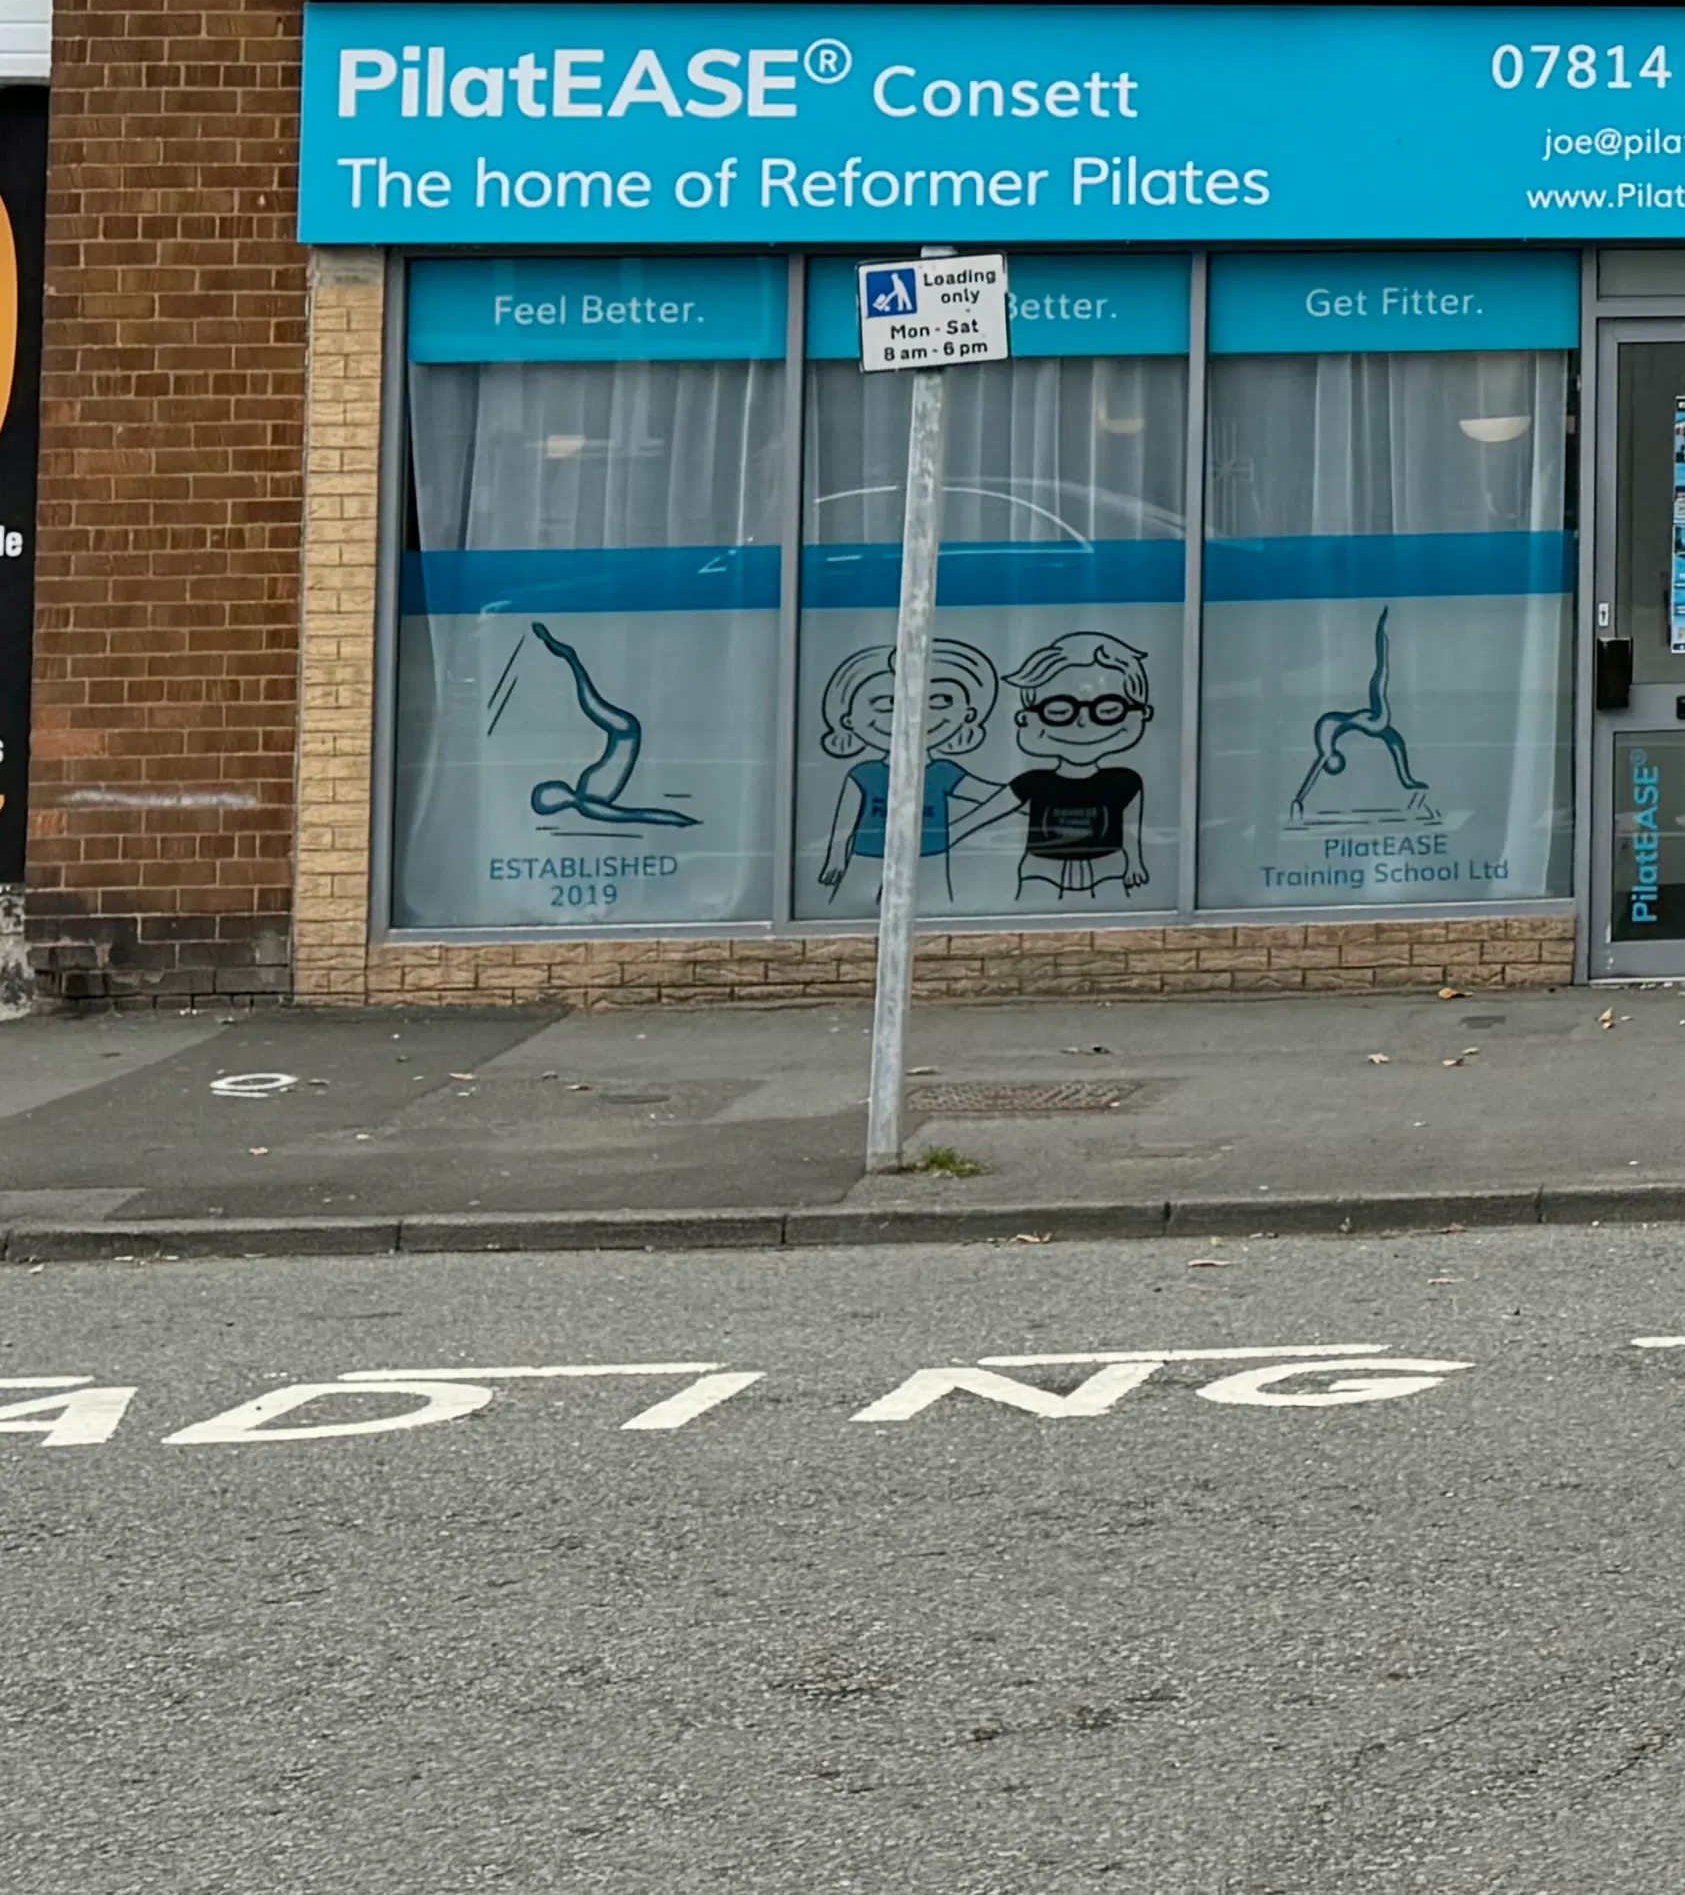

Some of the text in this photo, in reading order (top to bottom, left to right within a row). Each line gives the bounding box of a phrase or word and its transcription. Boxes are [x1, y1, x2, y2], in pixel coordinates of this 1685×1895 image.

[1491, 44, 1673, 90] 07814
[873, 65, 1139, 118] Consett
[336, 155, 1270, 209] The home of Reformer Pilates
[923, 269, 997, 288] Loading
[940, 288, 981, 305] only
[1304, 288, 1485, 318] Get Fitter.
[493, 295, 706, 326] Feel Better.
[890, 324, 931, 340] Mon
[946, 319, 979, 335] Sat
[884, 347, 895, 362] 8
[900, 348, 928, 360] am
[943, 342, 955, 356] 6
[960, 342, 988, 357] pm
[1325, 833, 1449, 859] PilatEASE
[490, 855, 678, 881] ESTABLISHED
[1261, 858, 1509, 890] Training School Ltd
[550, 884, 619, 907] 2019
